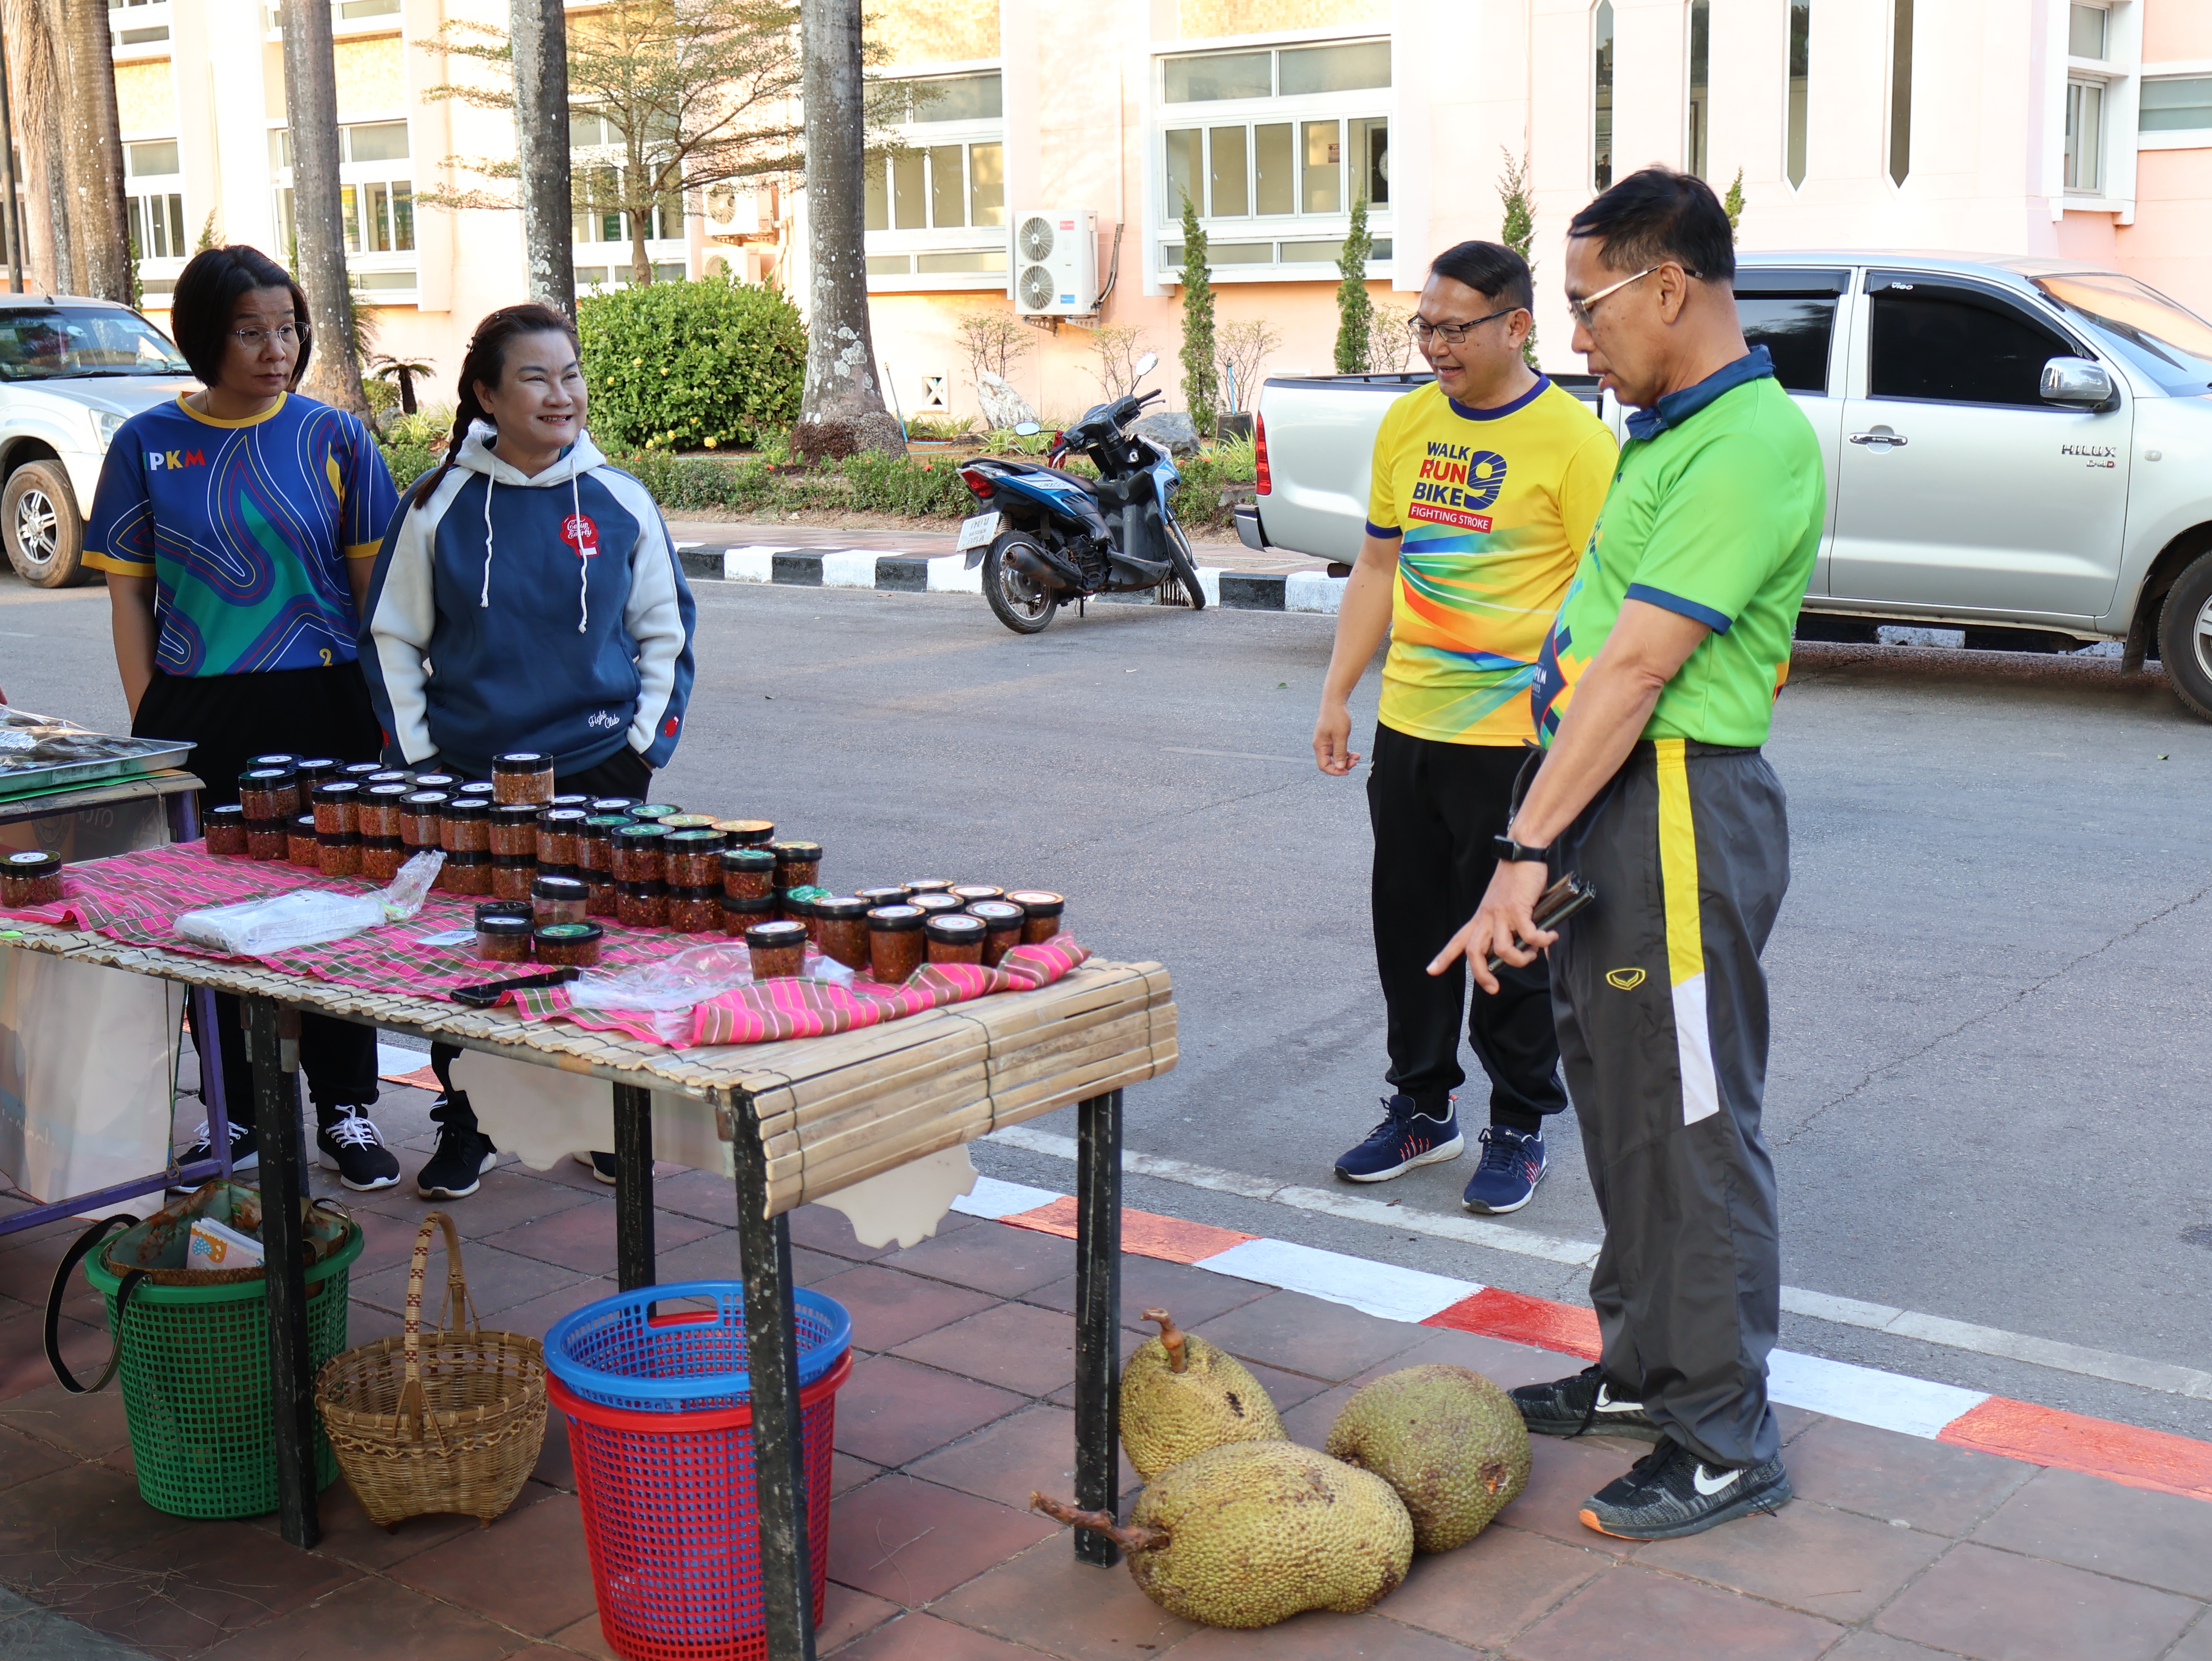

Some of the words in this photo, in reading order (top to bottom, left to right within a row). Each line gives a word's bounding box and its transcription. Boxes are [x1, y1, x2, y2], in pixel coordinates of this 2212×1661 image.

[1427, 441, 1471, 461] WALK
[2061, 445, 2117, 458] HILUX
[1419, 458, 1467, 485] RUN
[1463, 451, 1507, 510] 9
[1412, 482, 1464, 507] BIKE
[1411, 506, 1457, 524] FIGHTING
[1458, 515, 1489, 530] STROKE
[588, 710, 607, 727] Fight
[604, 713, 620, 729] Club
